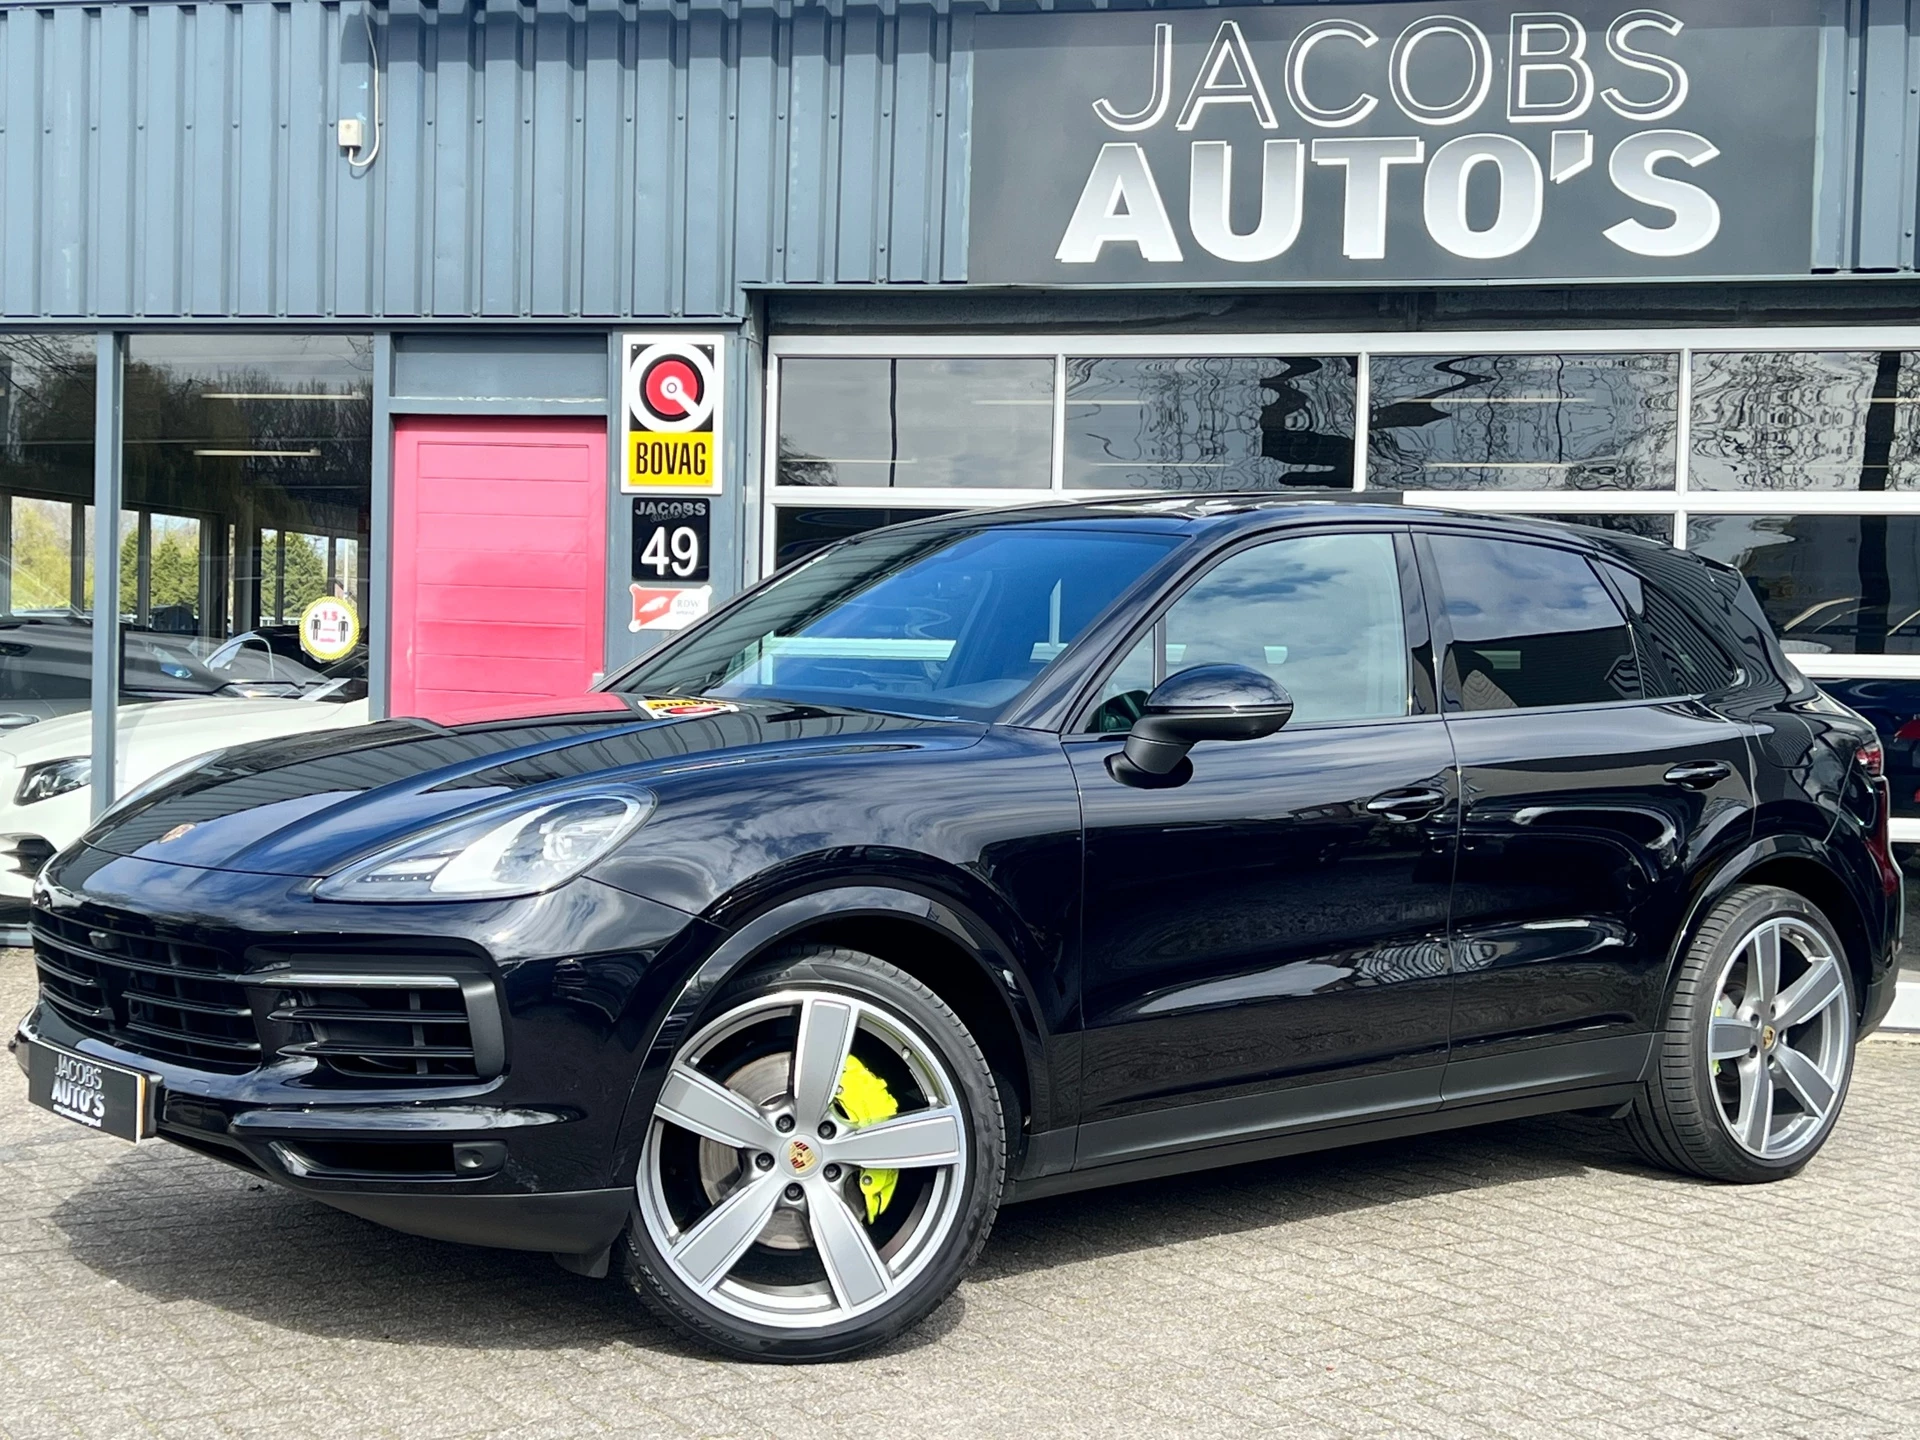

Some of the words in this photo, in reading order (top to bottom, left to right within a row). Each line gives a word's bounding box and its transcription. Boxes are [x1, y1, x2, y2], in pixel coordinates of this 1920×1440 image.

[1092, 9, 1689, 132] JACOBS
[1055, 129, 1721, 263] AUTO'S
[636, 441, 706, 476] BOVAG
[634, 501, 706, 516] JACOBS
[640, 526, 699, 577] 49
[54, 1054, 102, 1090] JACOBS
[51, 1078, 105, 1117] AUTO'S
